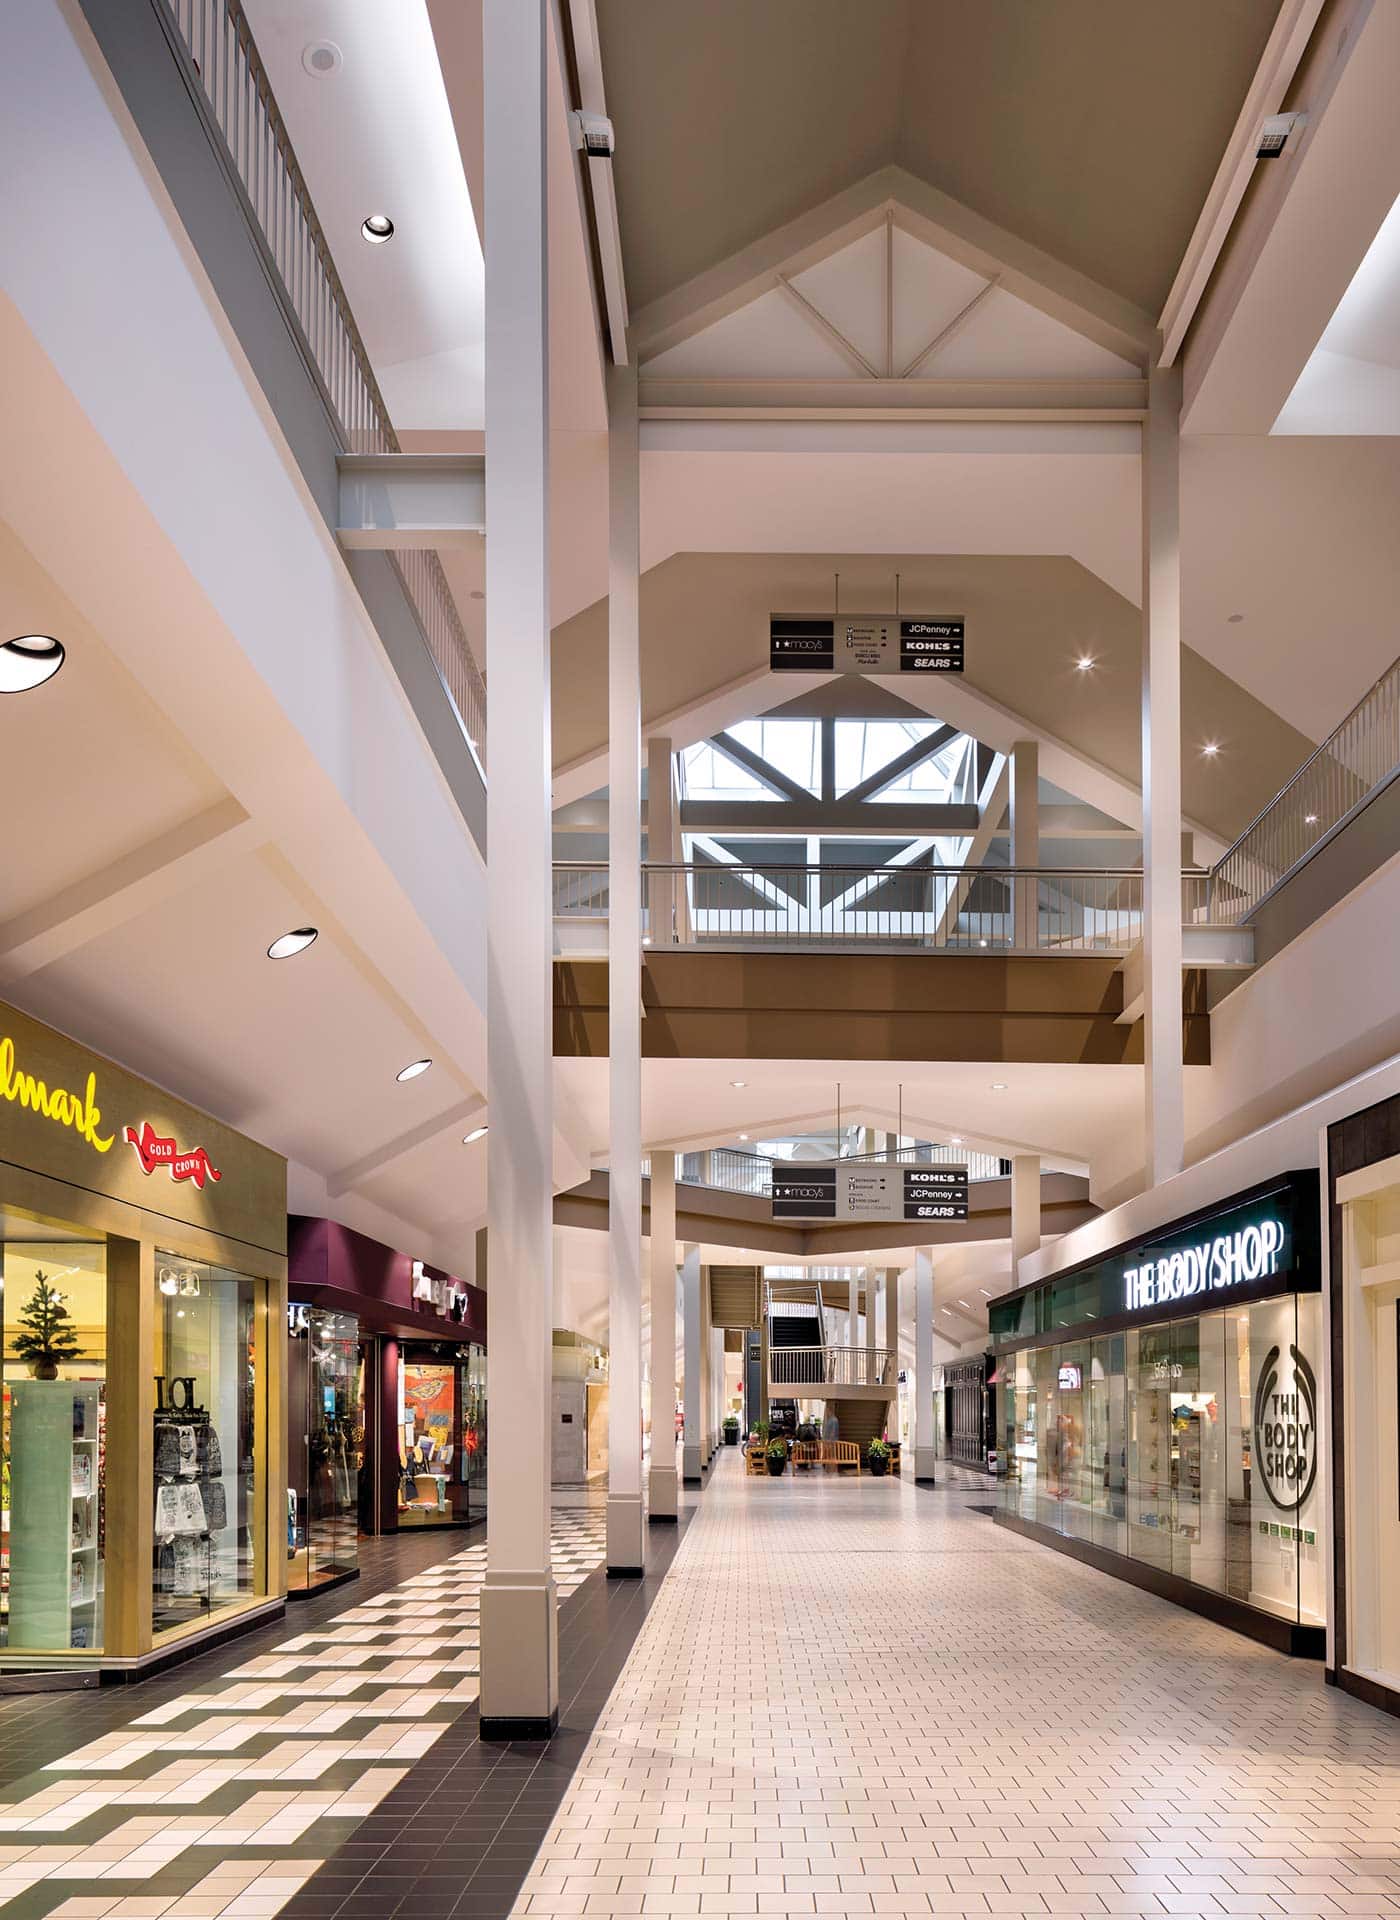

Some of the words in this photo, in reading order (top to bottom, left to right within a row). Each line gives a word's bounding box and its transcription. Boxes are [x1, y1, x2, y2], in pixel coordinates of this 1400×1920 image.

[909, 624, 951, 636] JCPenney
[906, 642, 951, 650] KOHL'S
[914, 658, 951, 668] SEARS
[150, 1143, 172, 1156] GOLD
[175, 1159, 201, 1173] CROWN
[910, 1174, 955, 1182] KOHL'S
[910, 1189, 953, 1200] JCPenney
[917, 1206, 955, 1217] SEARS
[1124, 1263, 1155, 1310] THE
[1158, 1243, 1211, 1302] BODY
[1212, 1221, 1278, 1288] SHOP
[1264, 1422, 1310, 1450] BODY
[1266, 1452, 1307, 1480] SHOP
